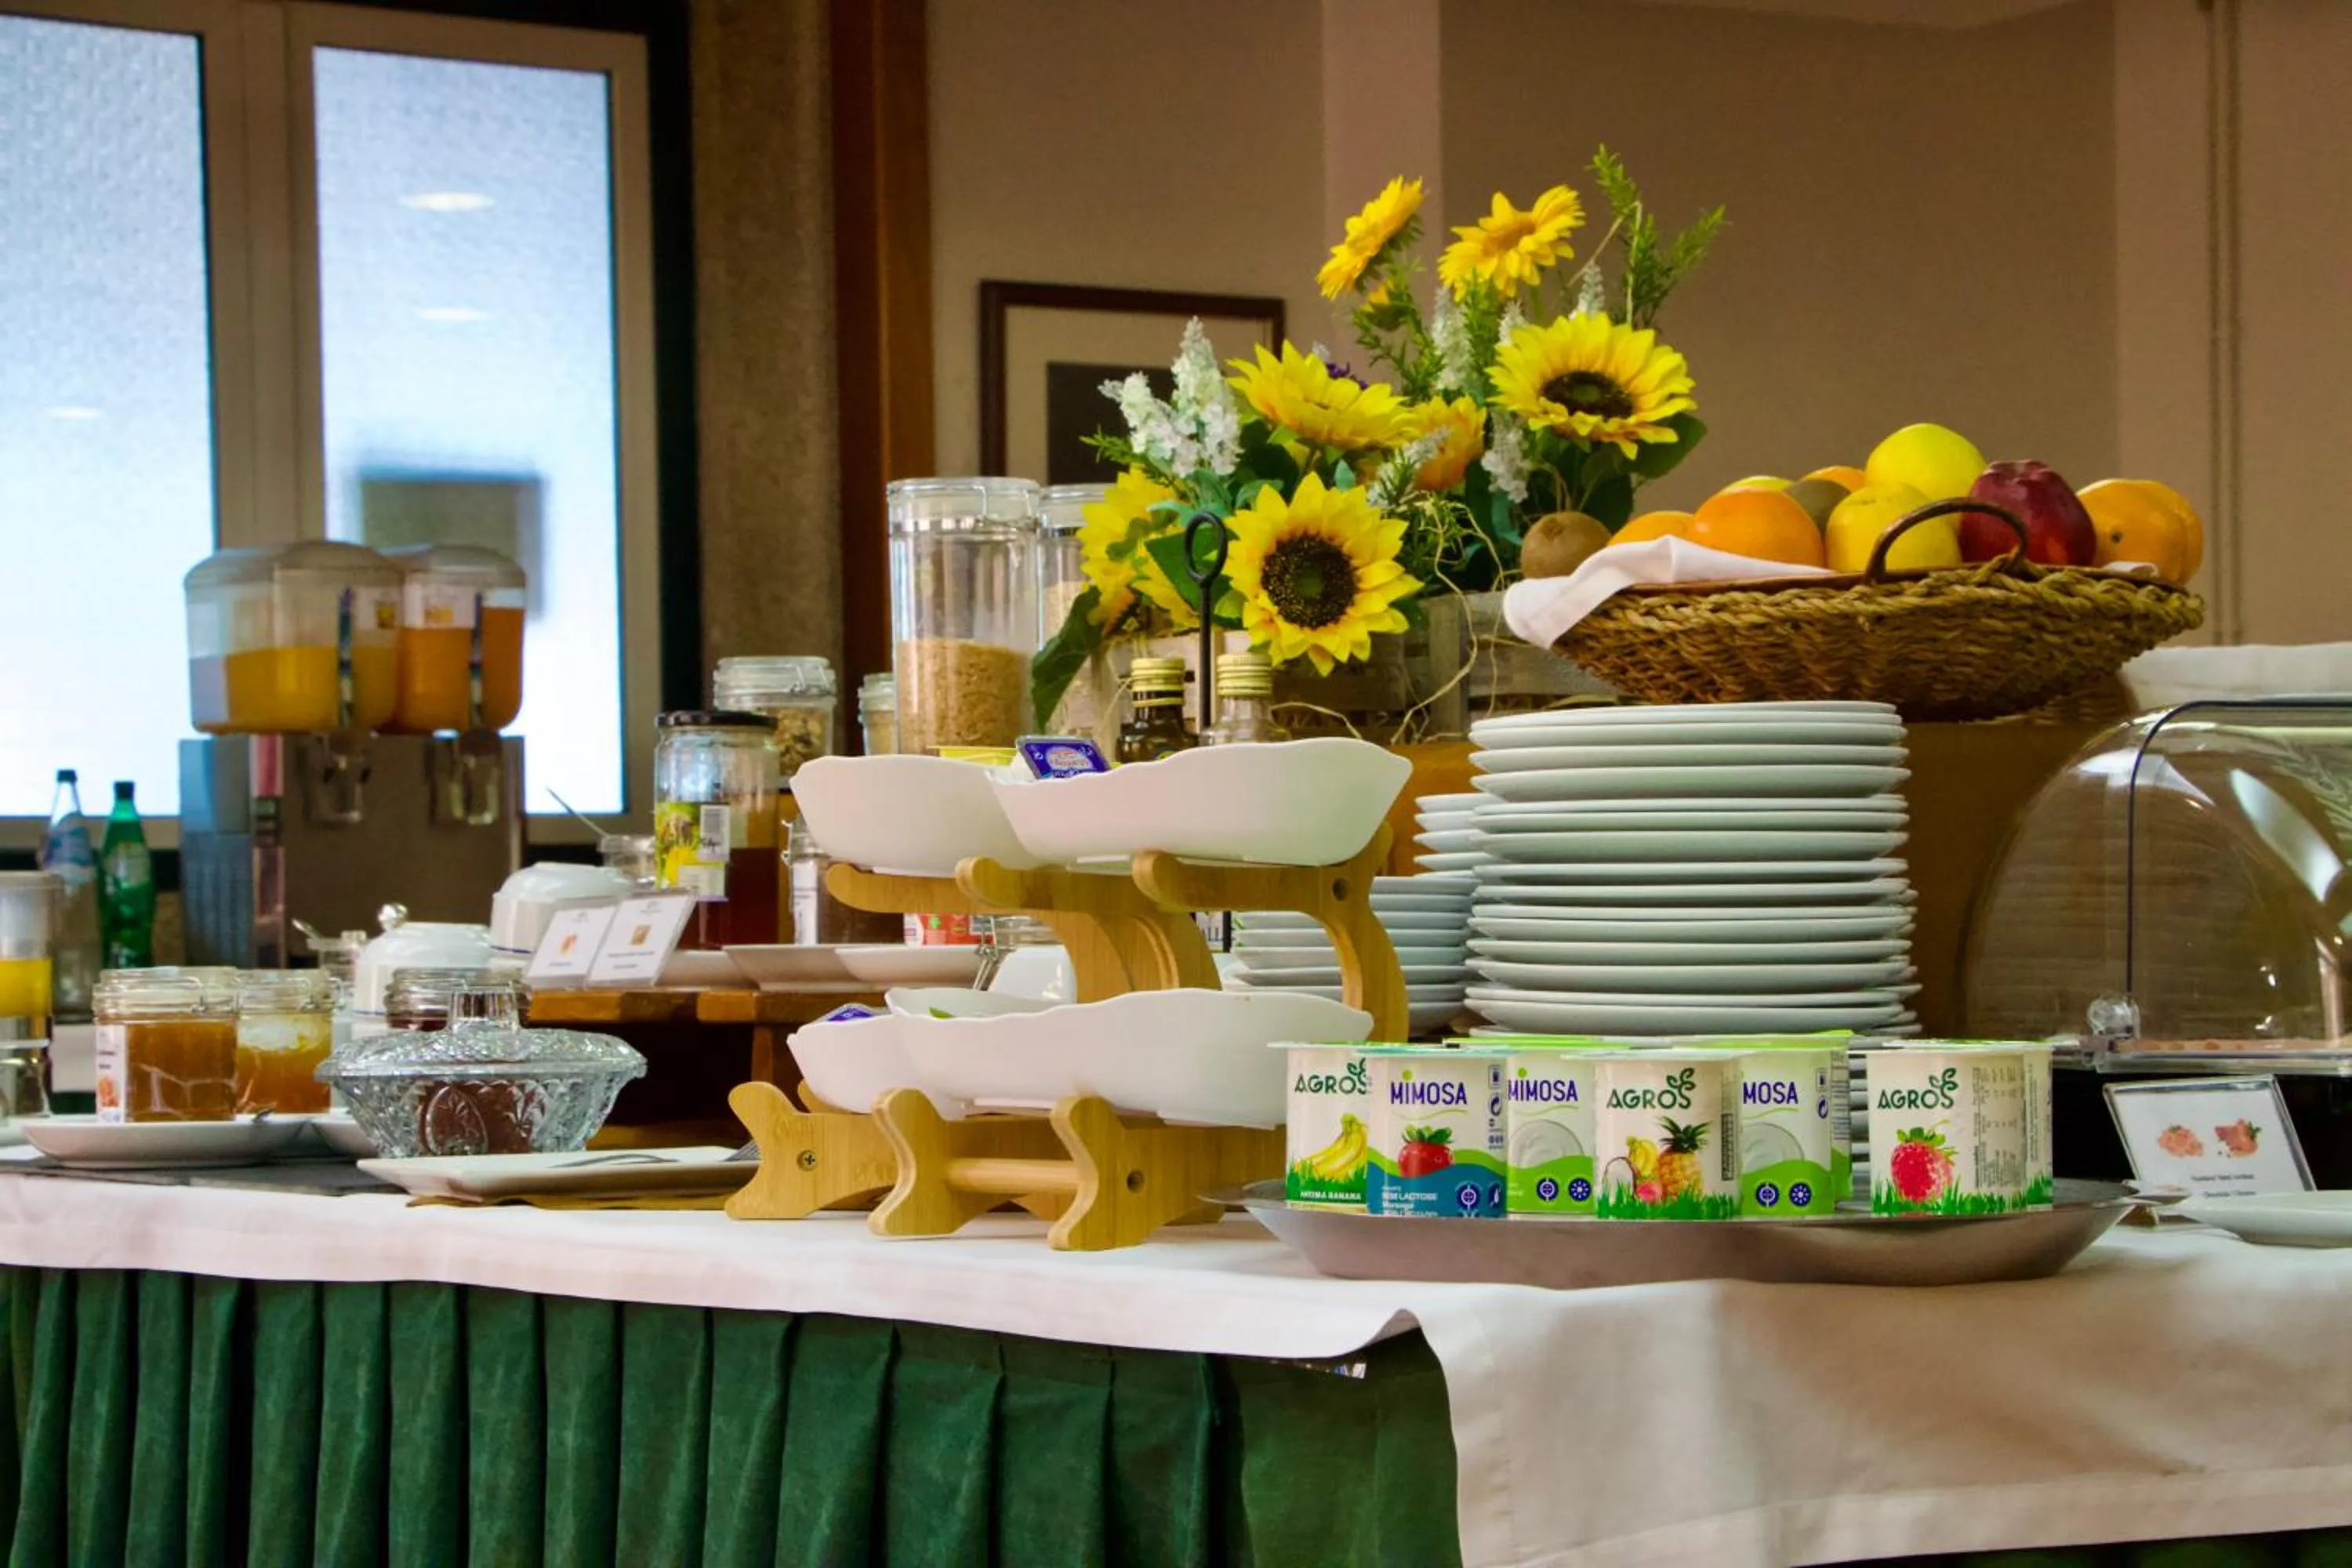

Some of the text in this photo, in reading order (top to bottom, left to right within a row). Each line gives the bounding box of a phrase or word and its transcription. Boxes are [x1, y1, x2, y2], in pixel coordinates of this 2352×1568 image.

[1294, 1065, 1367, 1094] AGROS
[1391, 1069, 1468, 1105] MIMOSA
[1508, 1067, 1579, 1102] MIMOSA
[1606, 1077, 1692, 1109] AGROS
[1743, 1081, 1798, 1104] MOSA
[1878, 1079, 1955, 1109] AGROS
